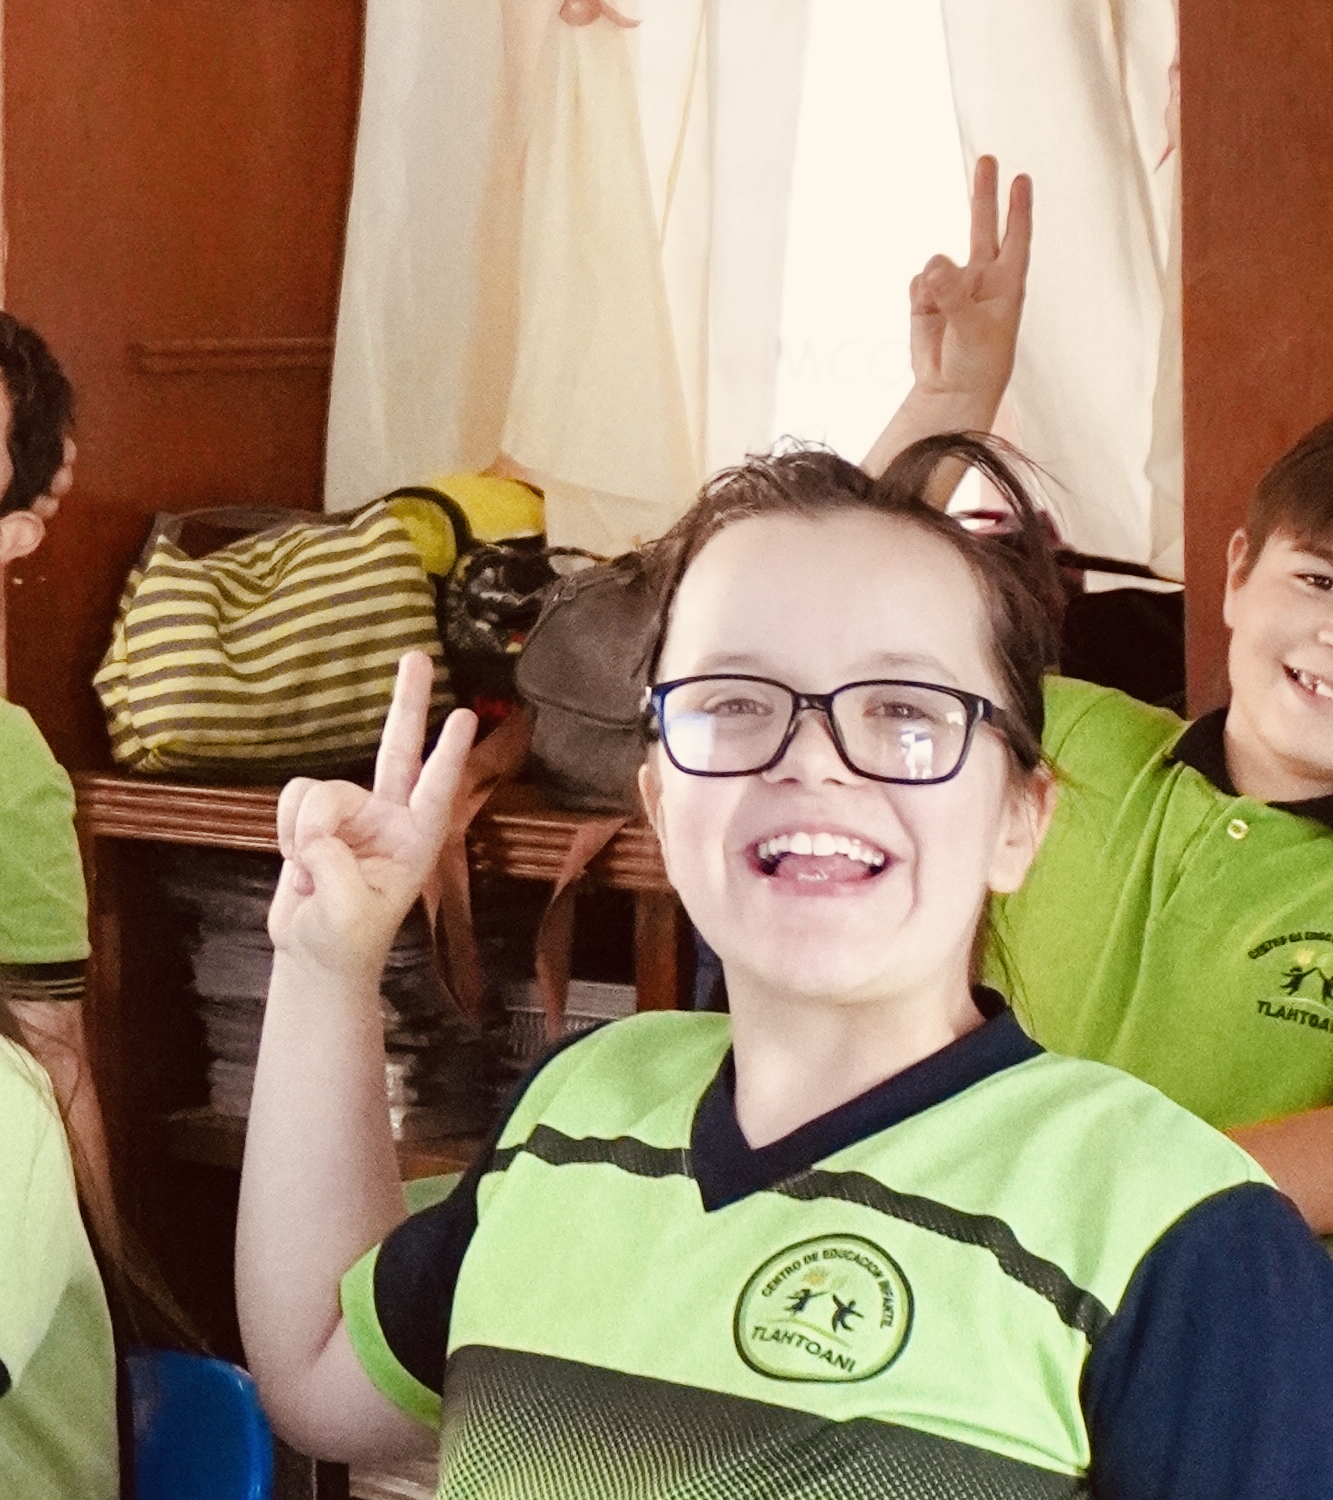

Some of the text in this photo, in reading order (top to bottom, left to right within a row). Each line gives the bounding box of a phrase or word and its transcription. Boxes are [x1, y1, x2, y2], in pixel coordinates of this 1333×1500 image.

[761, 1259, 802, 1298] CENTRO
[804, 1251, 820, 1266] DE
[751, 1325, 857, 1374] TLAHTOANI
